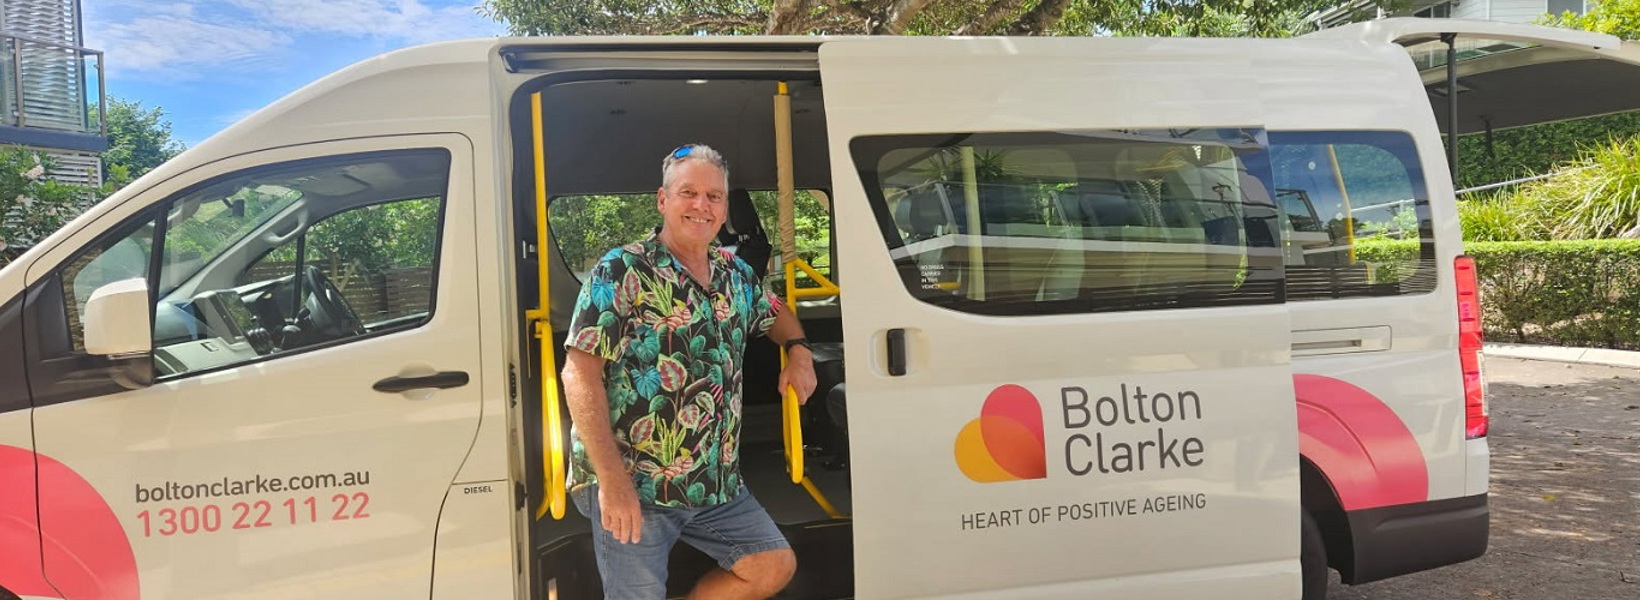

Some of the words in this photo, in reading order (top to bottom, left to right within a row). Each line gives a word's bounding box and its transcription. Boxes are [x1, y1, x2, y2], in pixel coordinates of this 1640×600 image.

[1061, 383, 1202, 429] Bolton
[1065, 428, 1204, 476] Clarke
[135, 471, 370, 503] boltonclarke.com.au
[464, 486, 493, 494] DIESEL
[136, 504, 221, 538] 1300
[232, 500, 272, 530] 22
[283, 496, 317, 525] 11
[331, 491, 370, 521] 22
[961, 509, 1023, 530] HEART
[1028, 507, 1052, 524] OF
[1057, 499, 1137, 522] POSITIVE
[1142, 493, 1207, 514] AGEING
